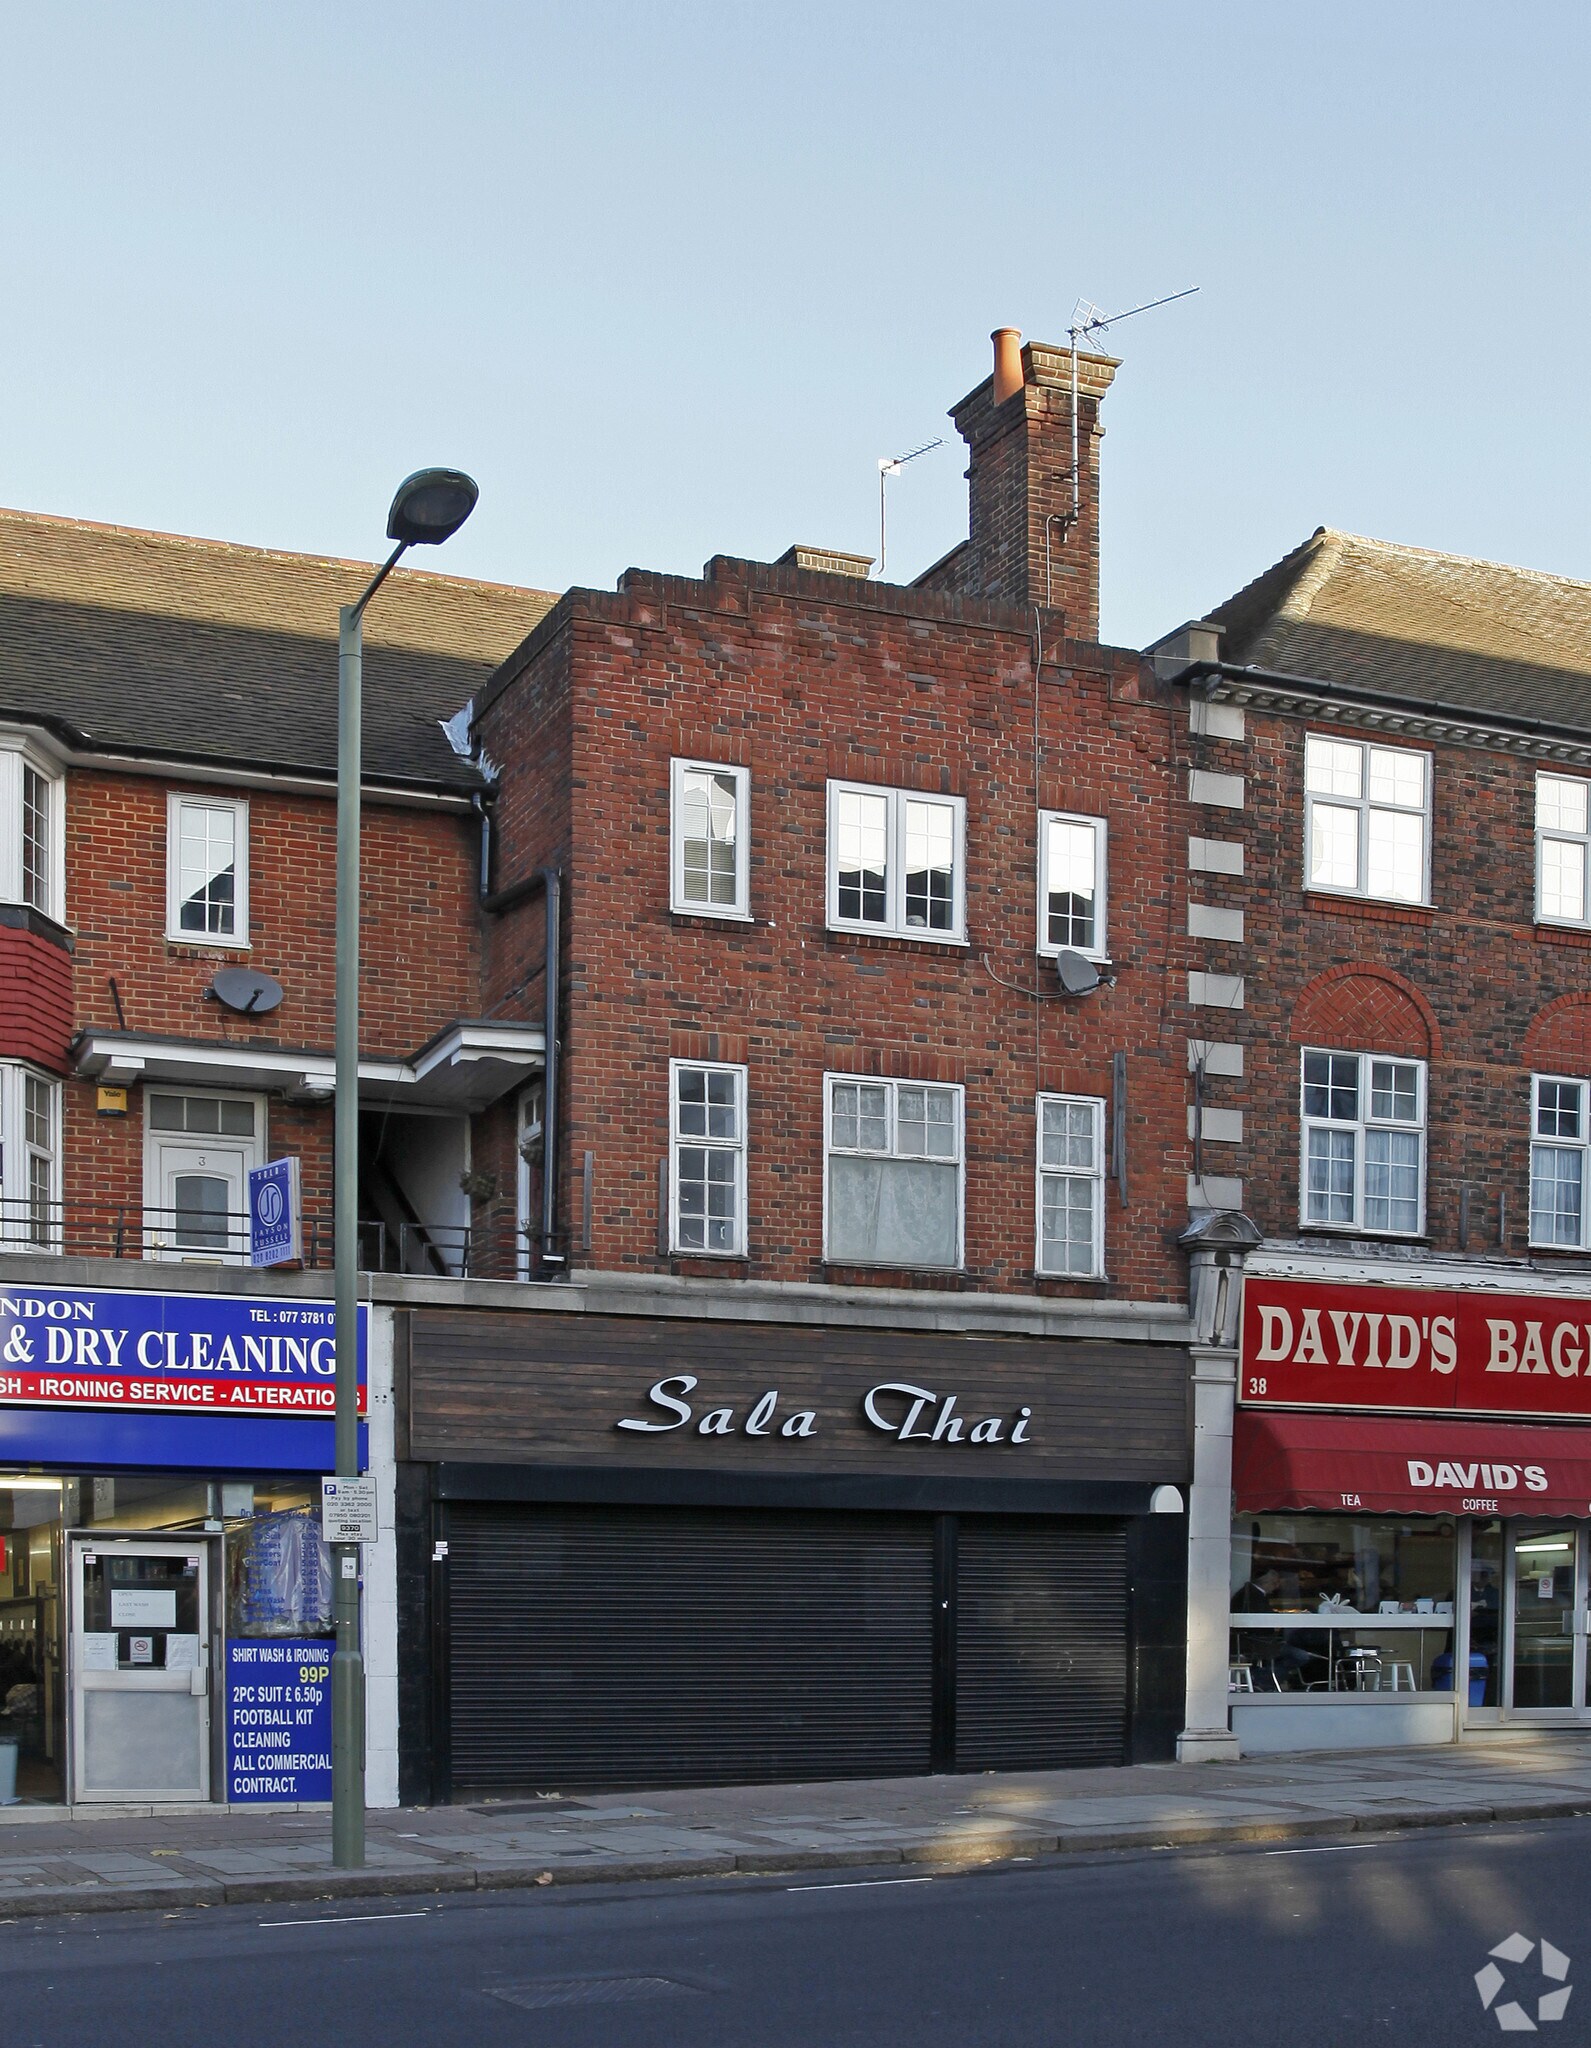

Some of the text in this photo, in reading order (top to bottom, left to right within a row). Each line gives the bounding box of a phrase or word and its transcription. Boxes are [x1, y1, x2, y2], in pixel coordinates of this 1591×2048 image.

[198, 1156, 206, 1166] 3
[257, 1166, 279, 1180] SOLD
[254, 1222, 288, 1239] JAYSON
[254, 1232, 288, 1248] RUSSELL
[279, 1310, 298, 1323] 077
[301, 1311, 325, 1324] 3781
[1255, 1305, 1457, 1374] DAVID'S
[3, 1324, 336, 1375] & DRY CLEANING
[40, 1378, 124, 1398] IRONING
[130, 1382, 215, 1402] SERVICE
[1249, 1377, 1267, 1395] 38
[616, 1375, 1032, 1443] Sala Thai
[1341, 1494, 1361, 1506] TEA
[1462, 1498, 1498, 1512] COFFEE
[232, 1648, 330, 1663] SHIRT WASH & IRONING
[299, 1666, 330, 1683] 99P
[233, 1686, 323, 1706] 2PC SUIT £ 6.50p
[233, 1709, 314, 1725] FOOTBALL KIT
[233, 1732, 291, 1748] CLEANING
[233, 1754, 333, 1771] ALL COMMERCIAL
[233, 1777, 298, 1793] CONTRACT.
